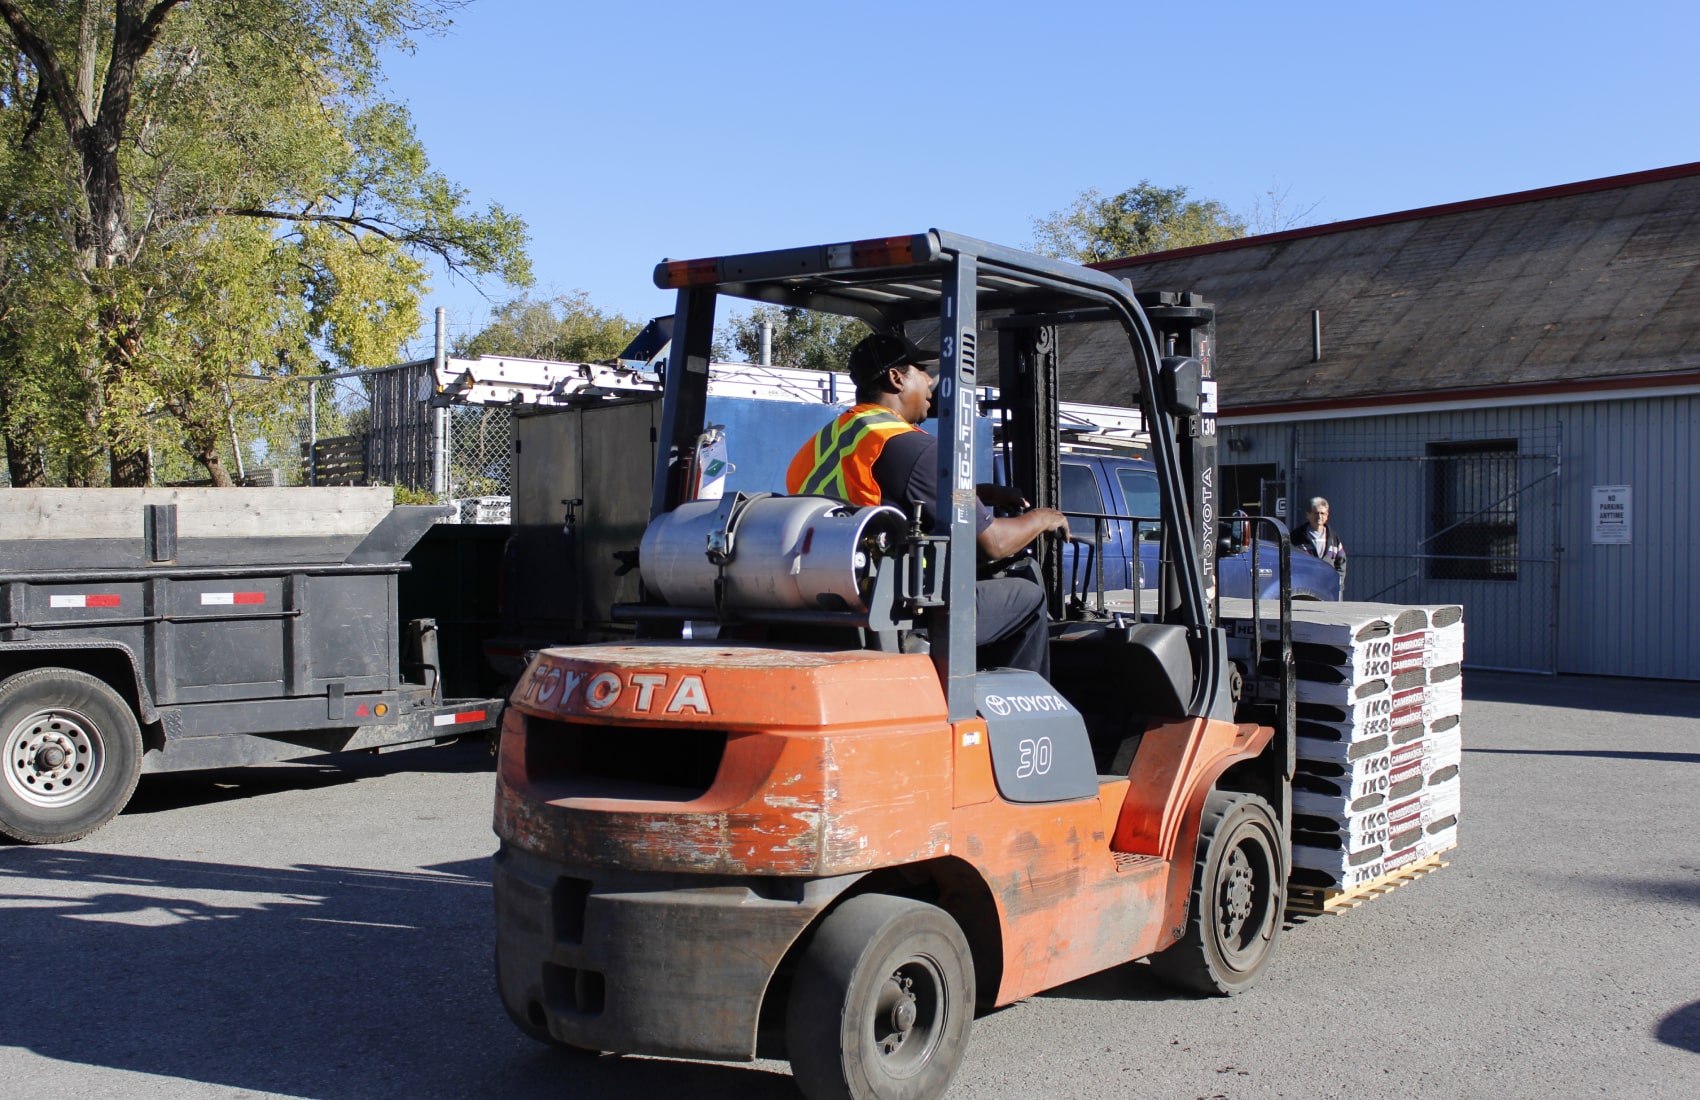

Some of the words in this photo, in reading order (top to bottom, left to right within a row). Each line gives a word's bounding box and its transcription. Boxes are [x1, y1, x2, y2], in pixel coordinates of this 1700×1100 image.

[1201, 418, 1216, 436] 130
[1202, 467, 1213, 575] TOYOTA
[1365, 642, 1391, 659] IKO
[1393, 637, 1425, 651] CAMBRIDGE
[1364, 660, 1389, 676] IKO
[1393, 657, 1423, 669] CAMBRIDGE
[524, 664, 713, 716] TOYOTA
[1008, 695, 1068, 711] TOYOTA
[1365, 699, 1390, 718] IKO
[1393, 692, 1424, 707] CAMBRIDGE
[1391, 710, 1422, 726] CAMBRIDGE
[1016, 736, 1053, 779] 30
[1364, 756, 1389, 775] IKO
[1391, 749, 1423, 762] CAMBRIDGE
[1362, 775, 1388, 795] IKO
[1390, 766, 1421, 782] CAMBRIDGE
[1361, 812, 1386, 830] IKO
[1361, 831, 1386, 845] IKO
[1355, 863, 1381, 882] IKO
[1384, 853, 1416, 870] CAMBRIDGE
